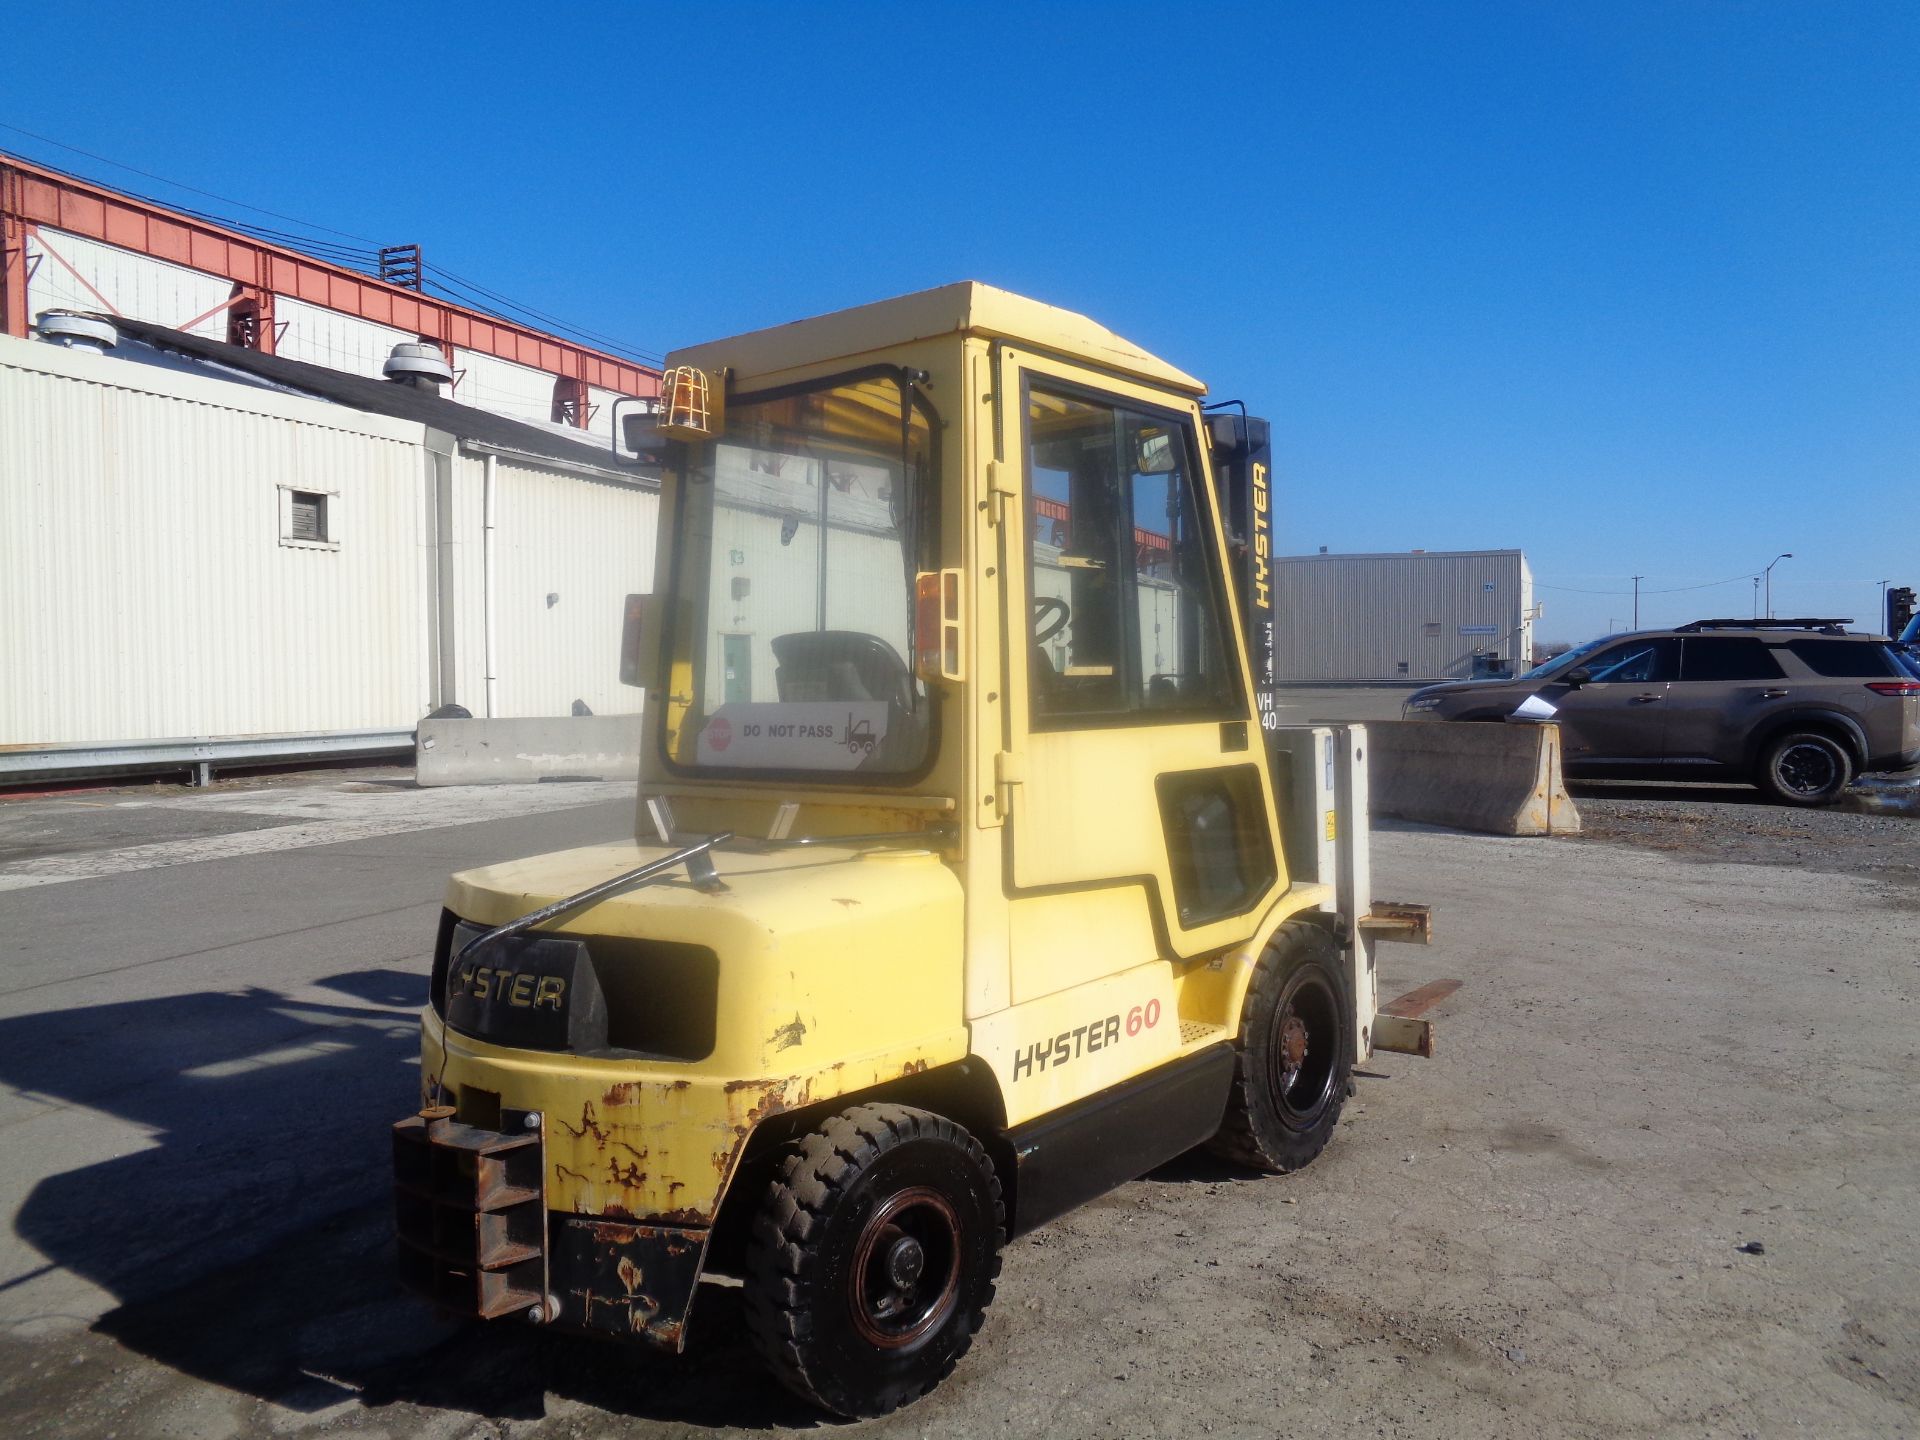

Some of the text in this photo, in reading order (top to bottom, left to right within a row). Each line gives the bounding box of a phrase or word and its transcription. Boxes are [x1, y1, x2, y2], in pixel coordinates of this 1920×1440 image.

[1253, 462, 1269, 609] HYSTER
[1257, 693, 1272, 711] VH
[1262, 712, 1277, 730] 40
[743, 724, 833, 738] DO NOT PASS
[1013, 998, 1161, 1082] HYSTER 60
